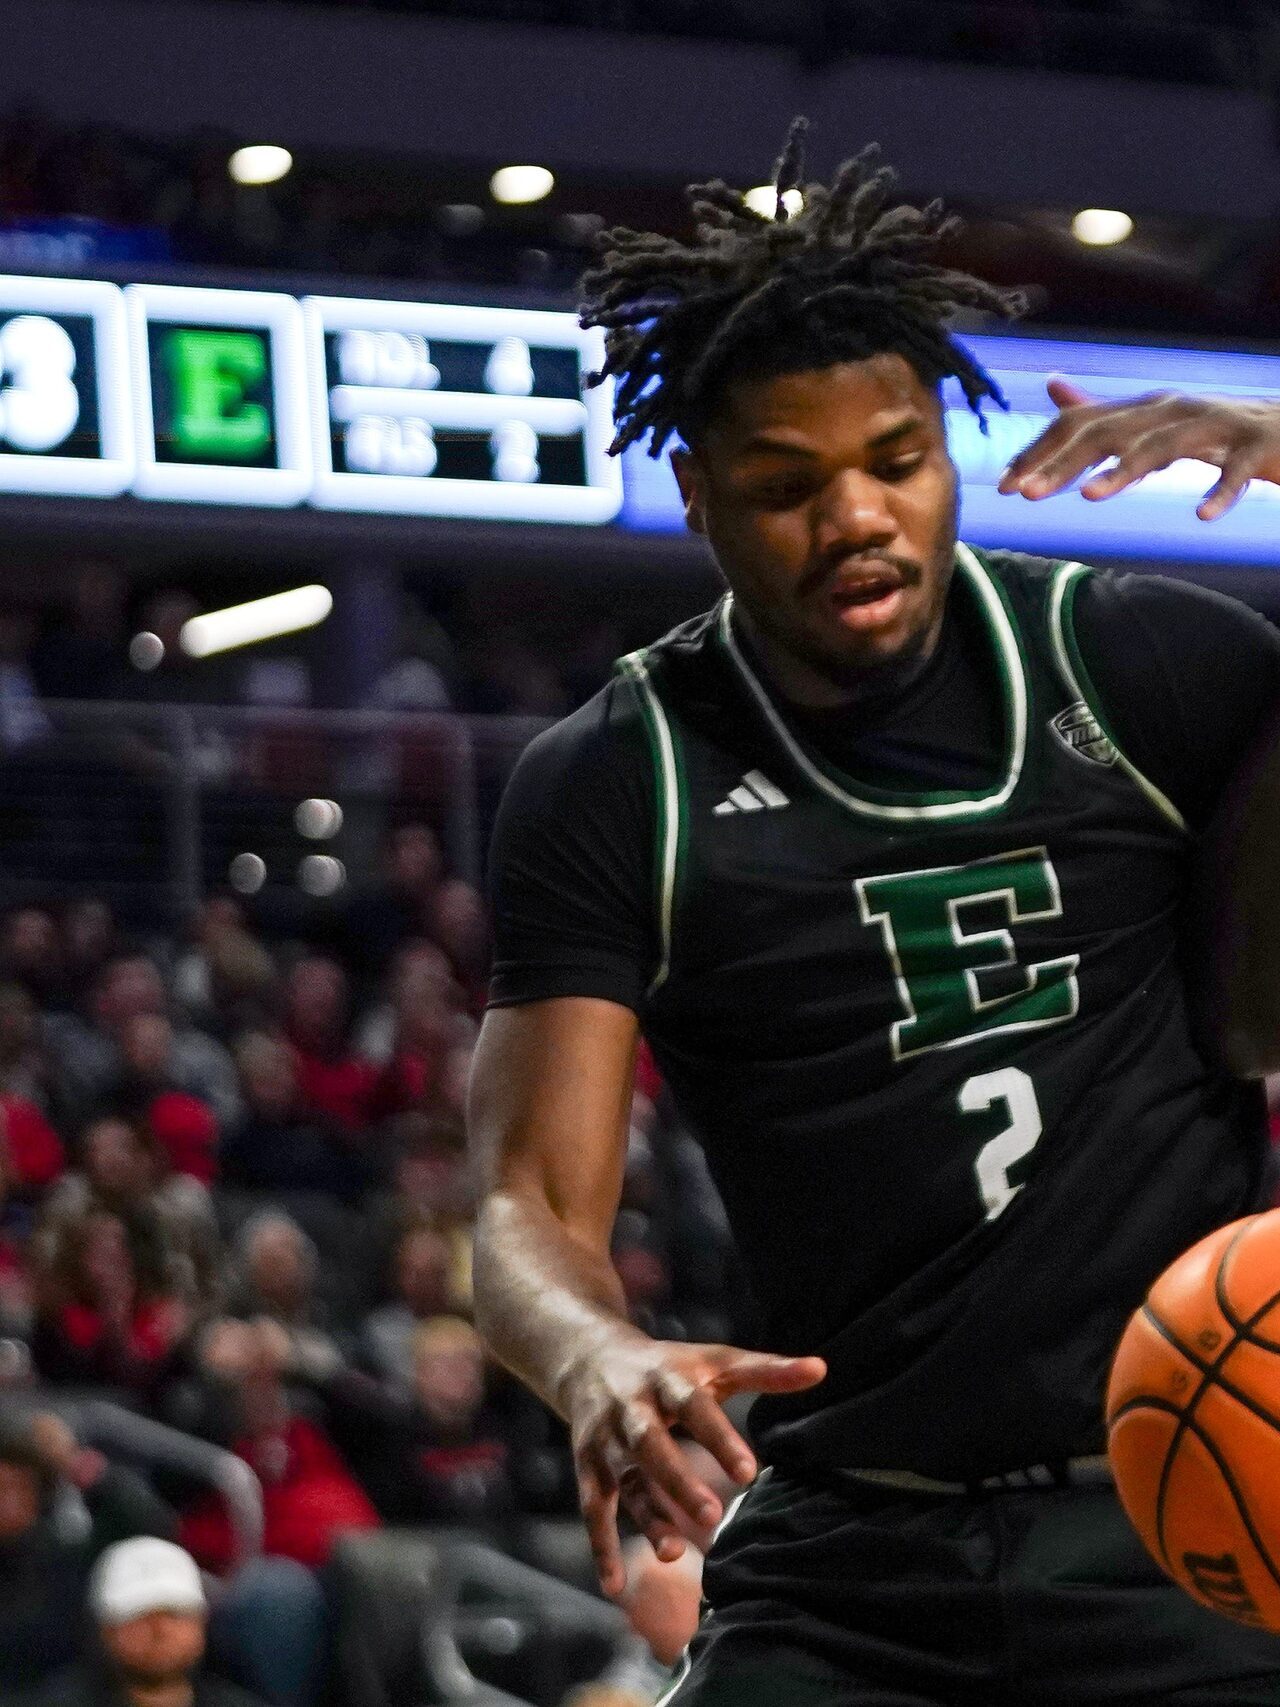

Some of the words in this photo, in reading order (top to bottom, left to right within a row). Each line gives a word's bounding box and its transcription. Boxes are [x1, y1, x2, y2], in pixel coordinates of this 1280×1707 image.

[168, 326, 272, 460] E
[853, 844, 1081, 1063] E
[957, 1066, 1042, 1222] 2
